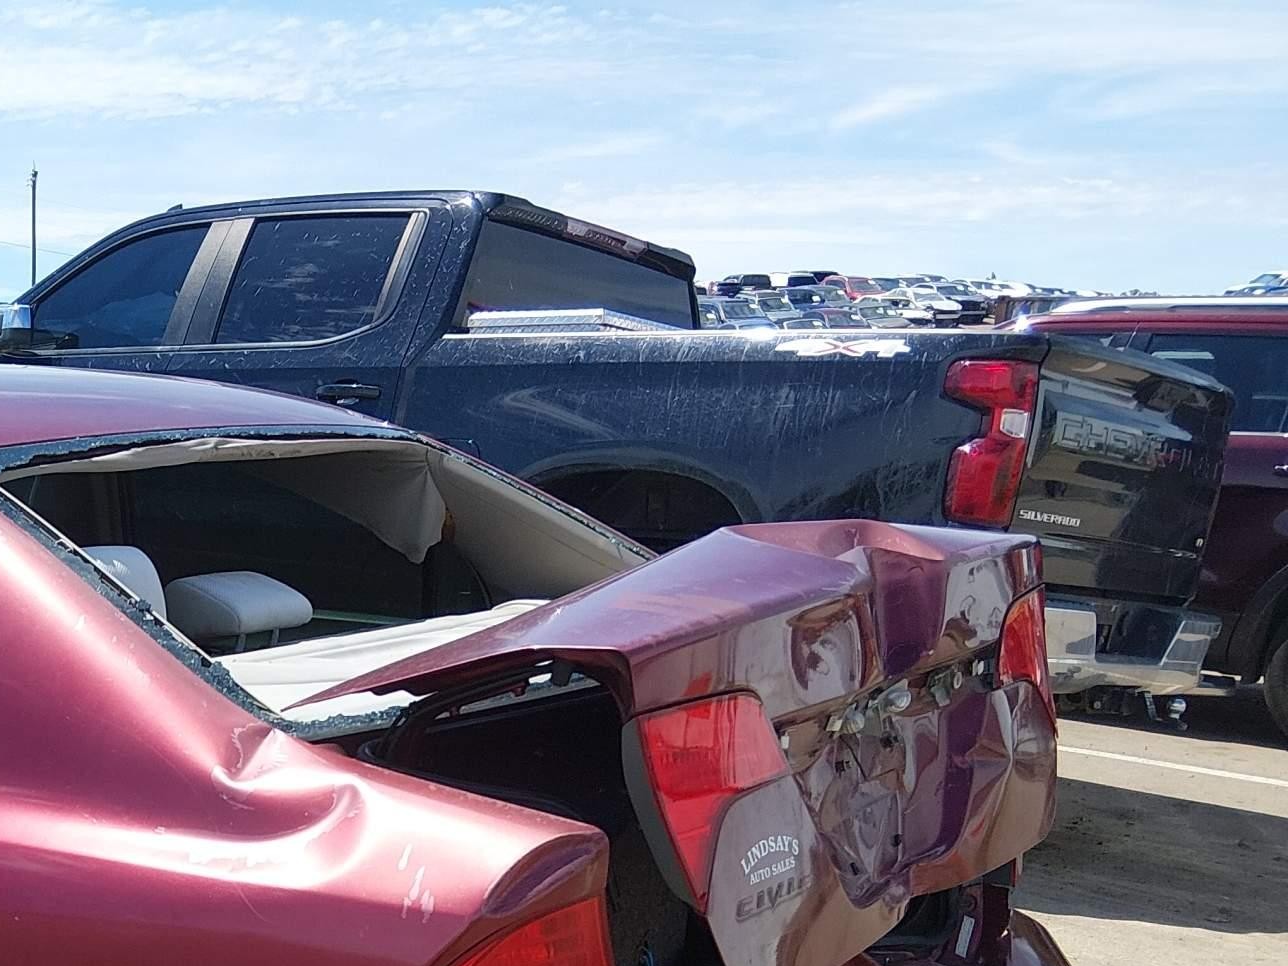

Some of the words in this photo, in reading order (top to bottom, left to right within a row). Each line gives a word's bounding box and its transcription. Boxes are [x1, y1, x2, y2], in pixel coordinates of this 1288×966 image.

[1018, 509, 1081, 527] SILVERADO
[741, 835, 799, 875] LINDSAY'S
[750, 867, 771, 885] AUTO
[772, 856, 796, 875] SALES
[735, 876, 812, 922] CIVIC
